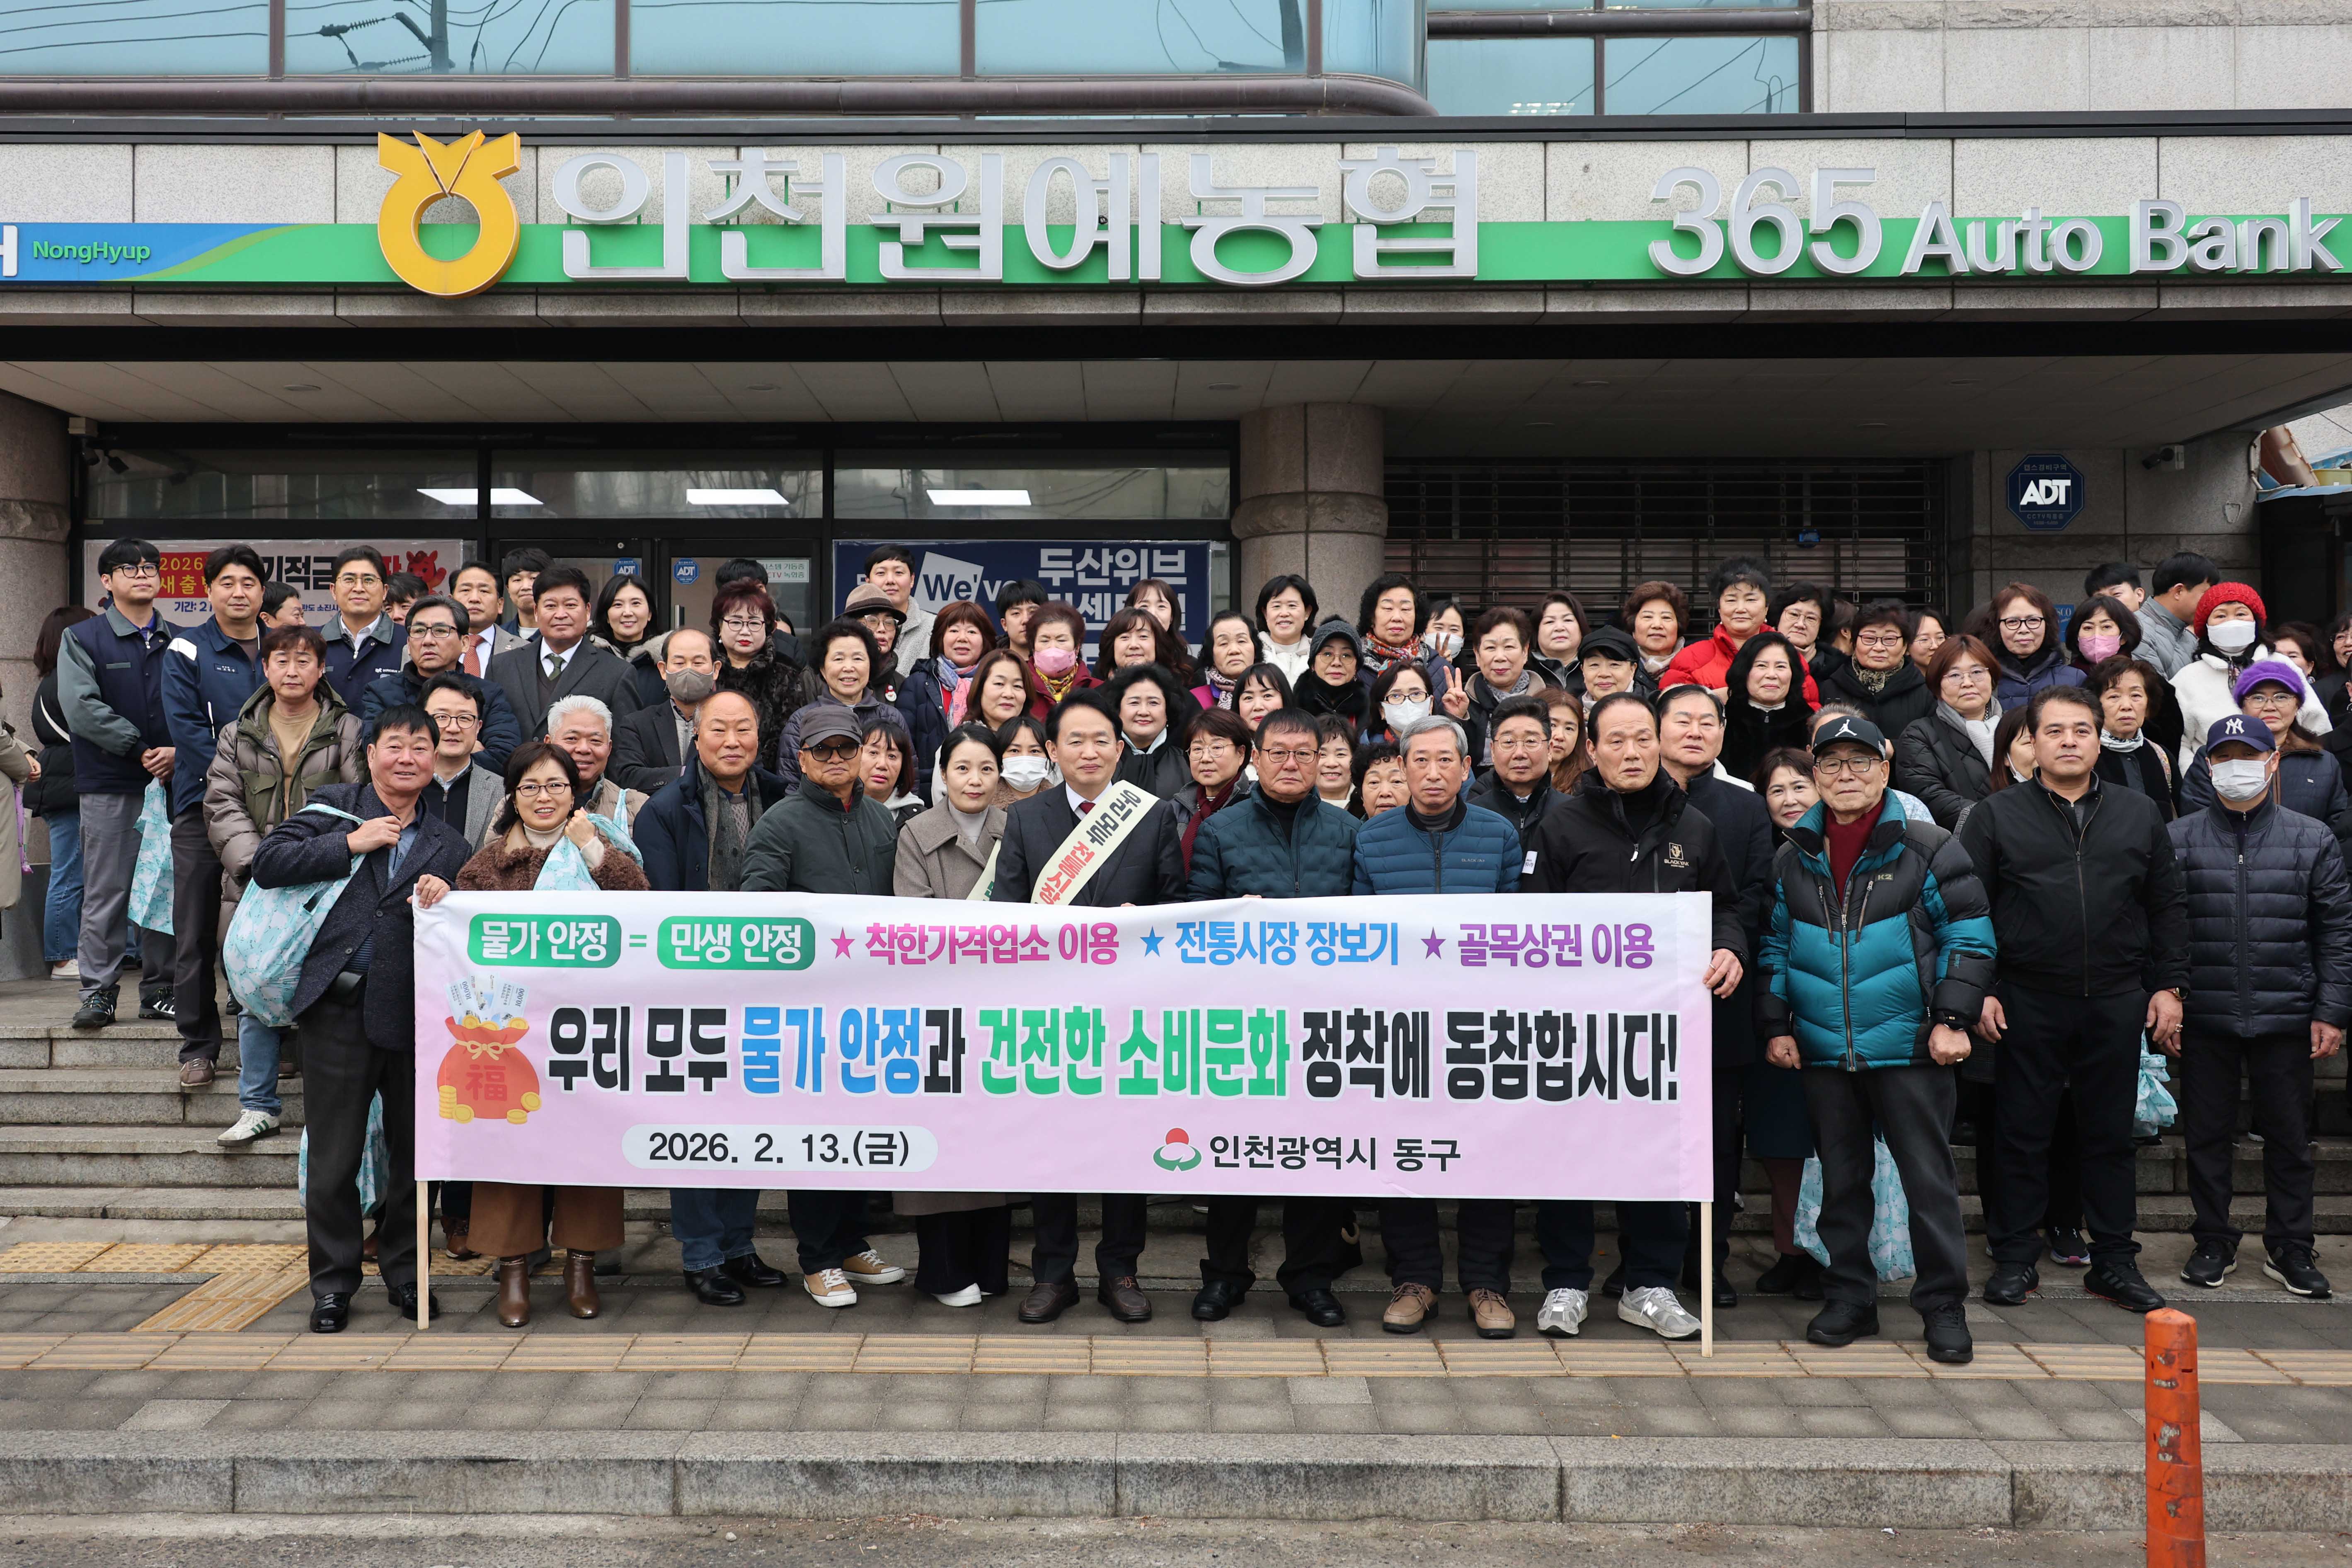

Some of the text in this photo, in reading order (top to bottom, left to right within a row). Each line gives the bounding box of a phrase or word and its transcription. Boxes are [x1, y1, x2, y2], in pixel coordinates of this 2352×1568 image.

[553, 147, 1478, 287] 인천원예농협
[1649, 166, 2343, 277] 365 Auto Bank
[33, 241, 150, 264] NongHyup
[2020, 479, 2071, 505] ADT
[160, 558, 202, 570] 2026
[261, 556, 337, 590] 기적금
[618, 566, 635, 575] ADT
[677, 566, 695, 576] ADT
[1038, 548, 1187, 586] 두산위브
[481, 921, 540, 960] 물가
[547, 921, 608, 961] 안정
[671, 923, 731, 963] 민생
[740, 924, 801, 964] 안정
[865, 922, 1119, 965] 착한가격업소 이용
[1175, 921, 1398, 966] 전통시장 장보기
[1458, 924, 1654, 969] 골목상권 이용
[549, 1007, 1677, 1101] 우리 모두 물가 안정과 건전한 소비문화 정착에 동참합시다!
[465, 1064, 508, 1101] 福
[649, 1131, 909, 1166] 2026. 2. 13.(금)
[1209, 1134, 1461, 1173] 인천광역시 동구
